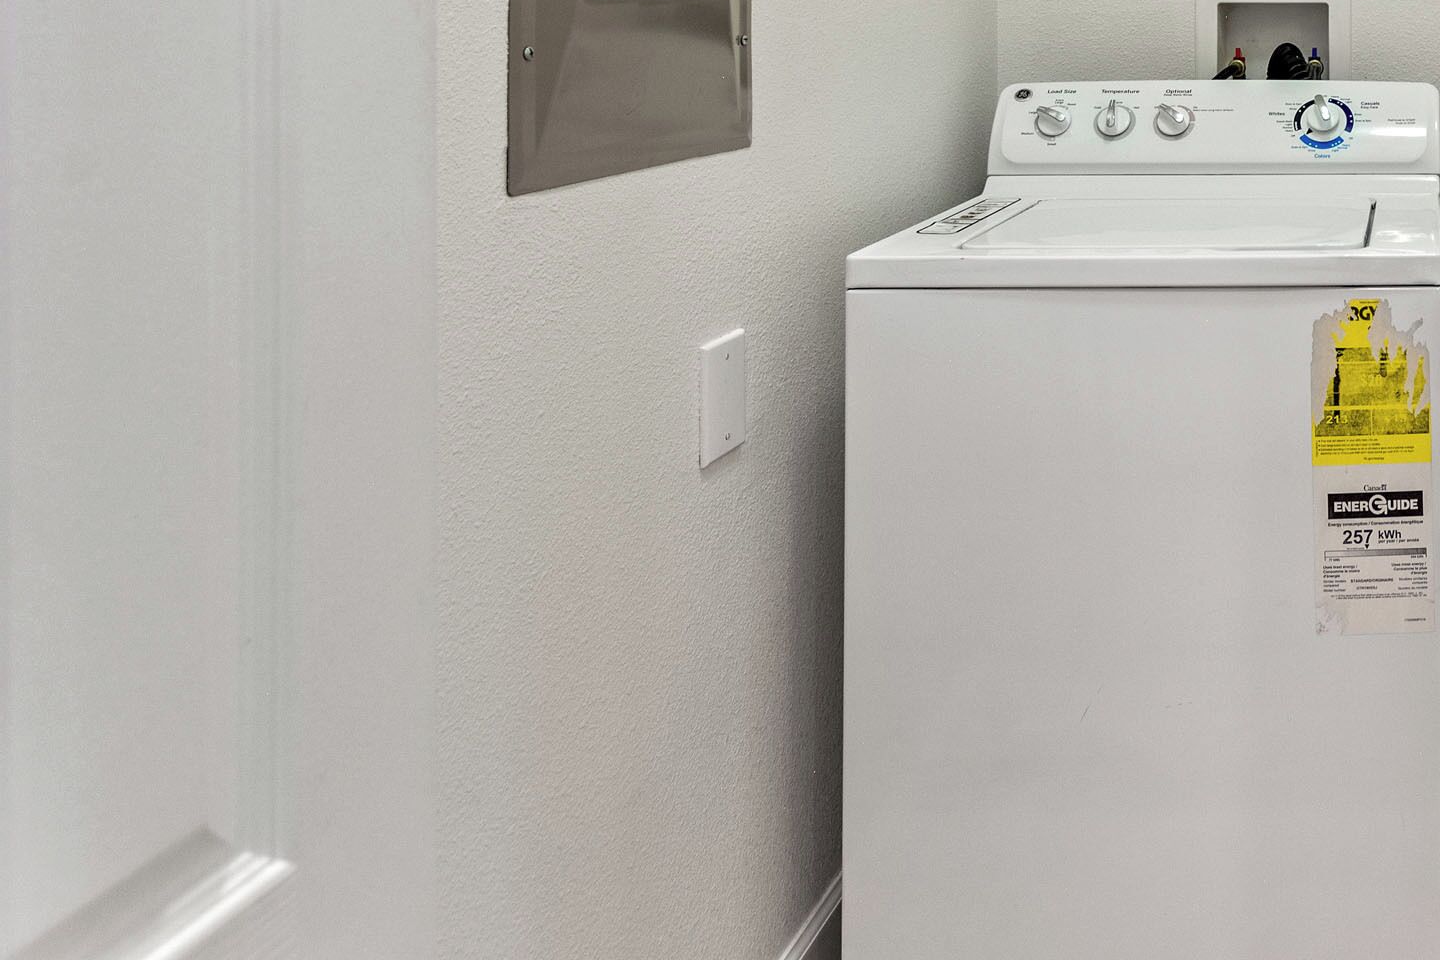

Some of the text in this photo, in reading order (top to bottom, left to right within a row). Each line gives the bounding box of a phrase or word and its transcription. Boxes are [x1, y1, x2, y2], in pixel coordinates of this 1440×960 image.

[1333, 493, 1419, 516] ENERGUIDE
[1342, 529, 1373, 545] 257
[1378, 529, 1402, 539] kWh
